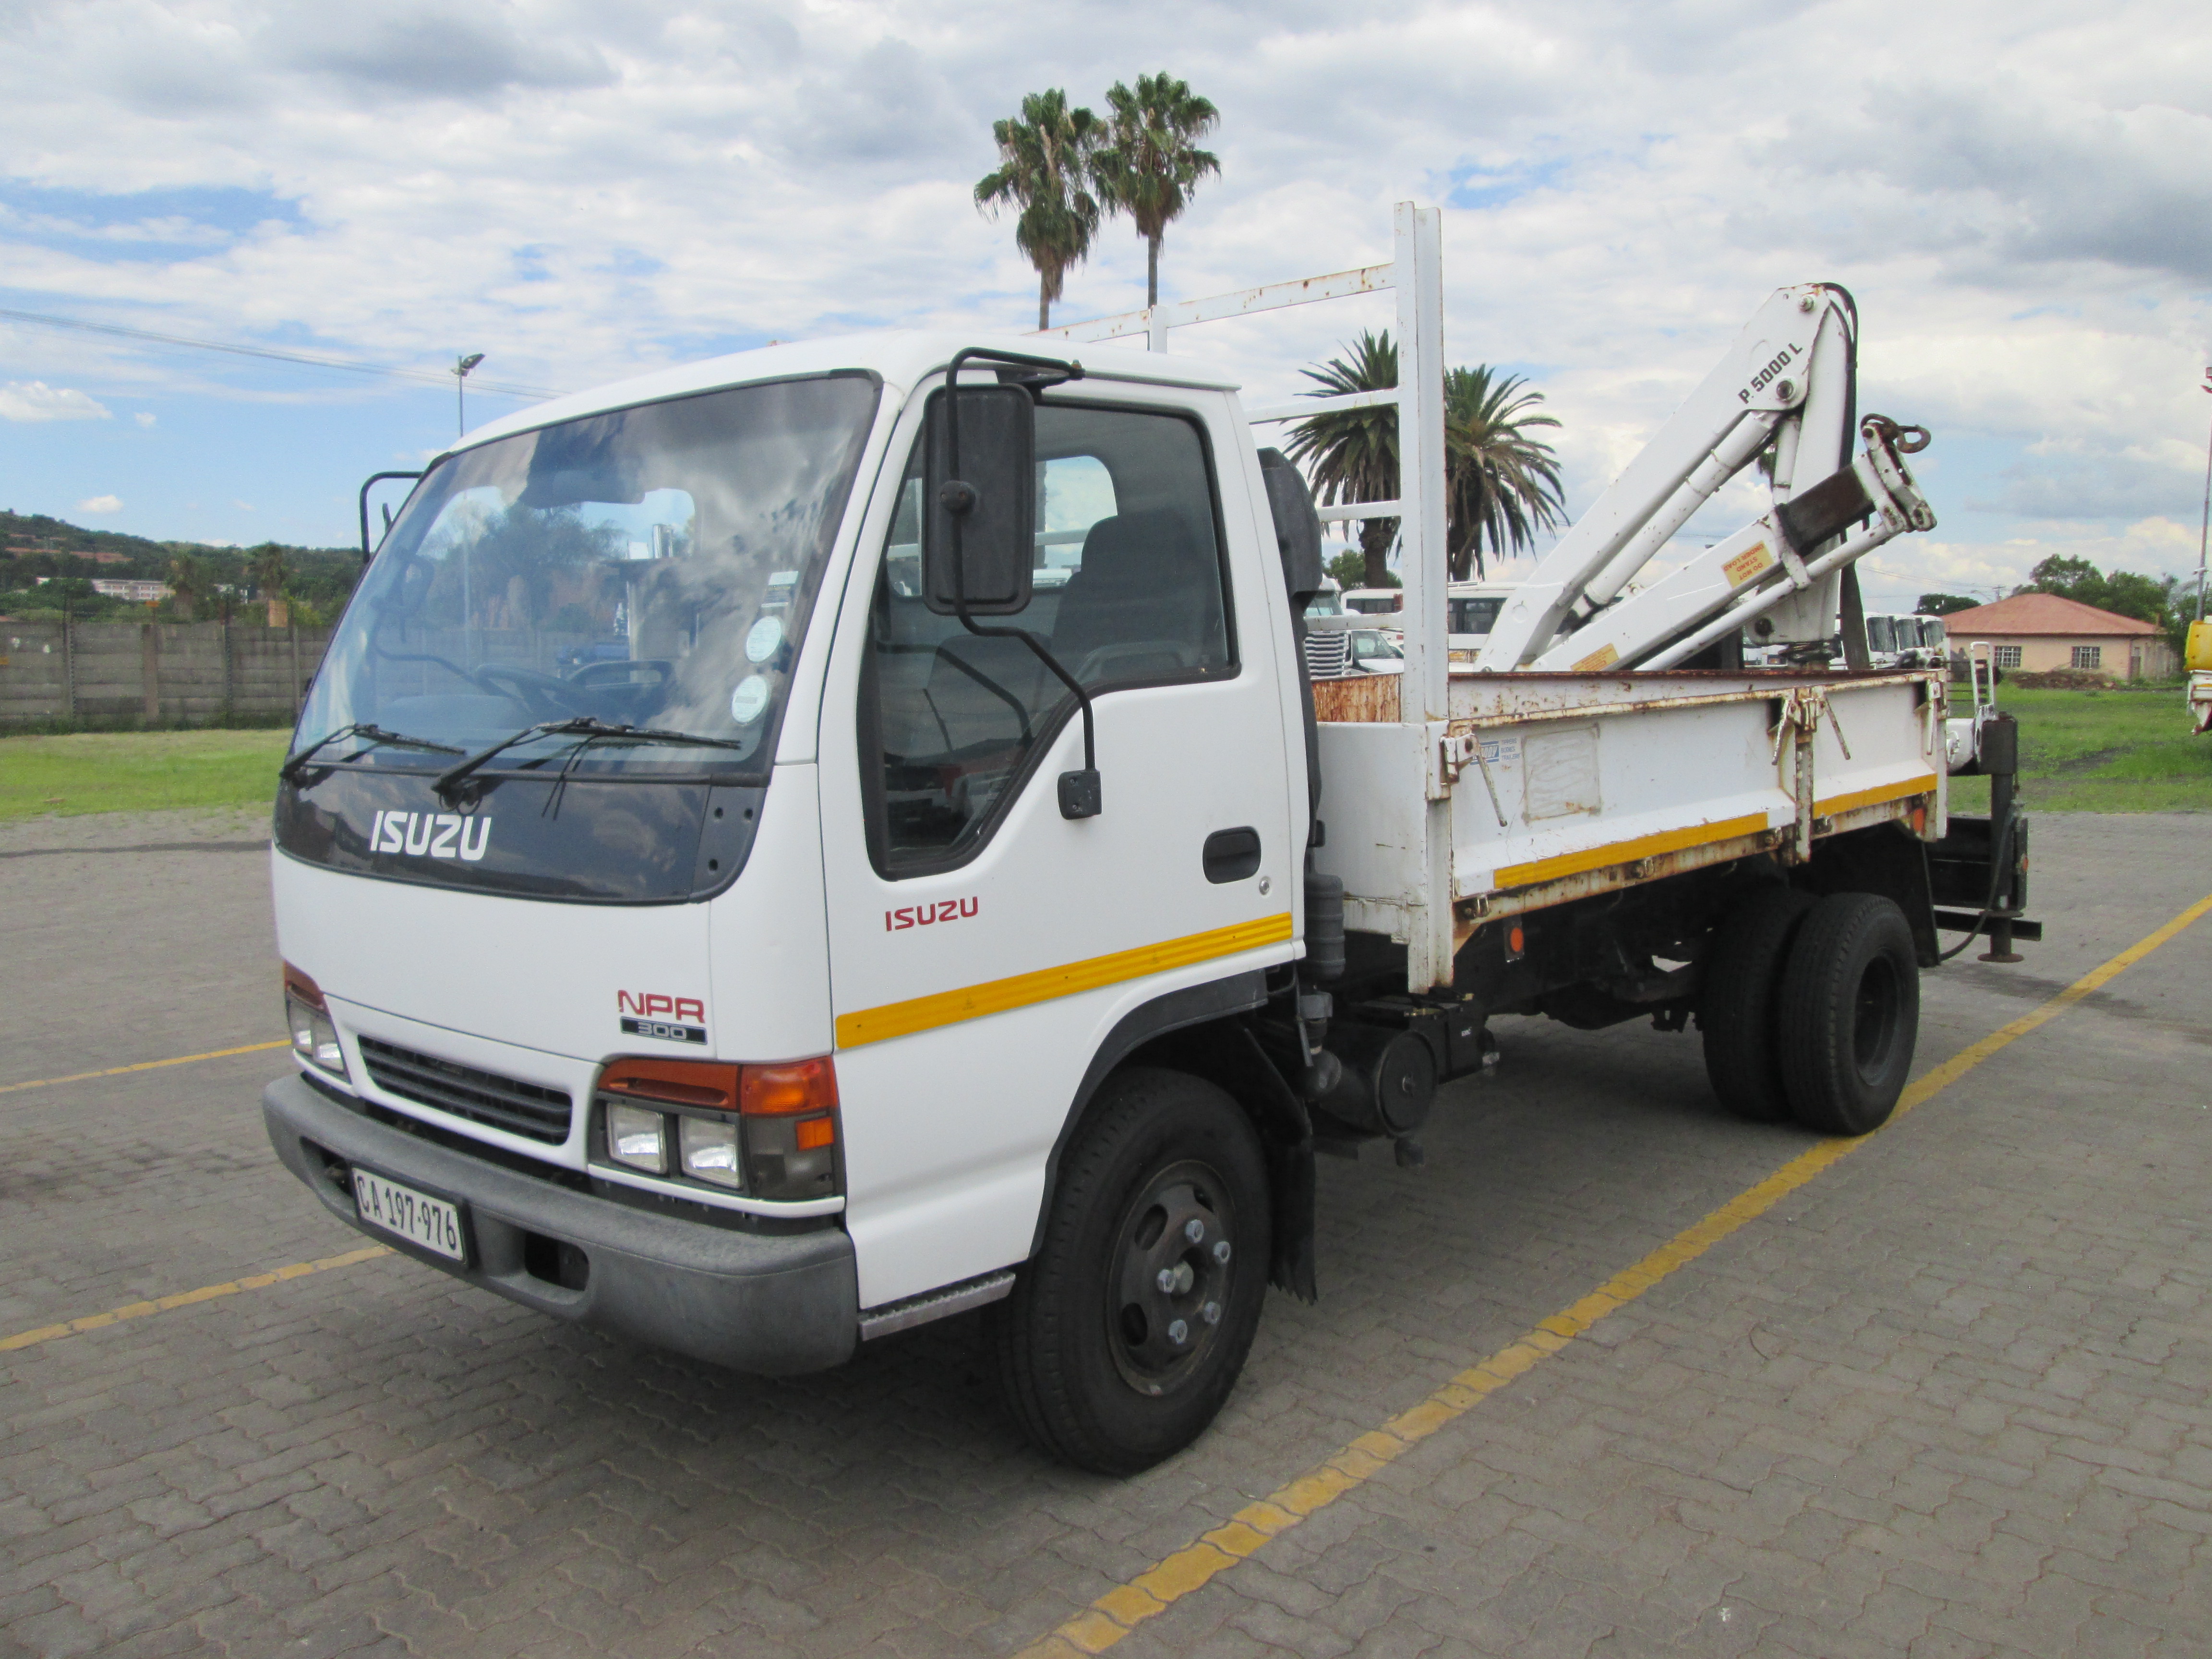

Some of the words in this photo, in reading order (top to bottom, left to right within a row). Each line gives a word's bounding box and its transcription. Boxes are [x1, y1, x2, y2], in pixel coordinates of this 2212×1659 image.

[1750, 351, 1791, 392] 5000
[1788, 343, 1803, 355] L
[1741, 543, 1764, 560] UNDER
[1723, 558, 1741, 571] LOAD
[1736, 556, 1757, 572] STAND
[1753, 562, 1763, 571] DO
[1739, 569, 1753, 580] NOT
[370, 810, 492, 861] ISUZU
[885, 896, 978, 931] ISUZU
[617, 989, 706, 1024] NPR
[637, 1021, 687, 1040] 300
[357, 1175, 383, 1220] CA
